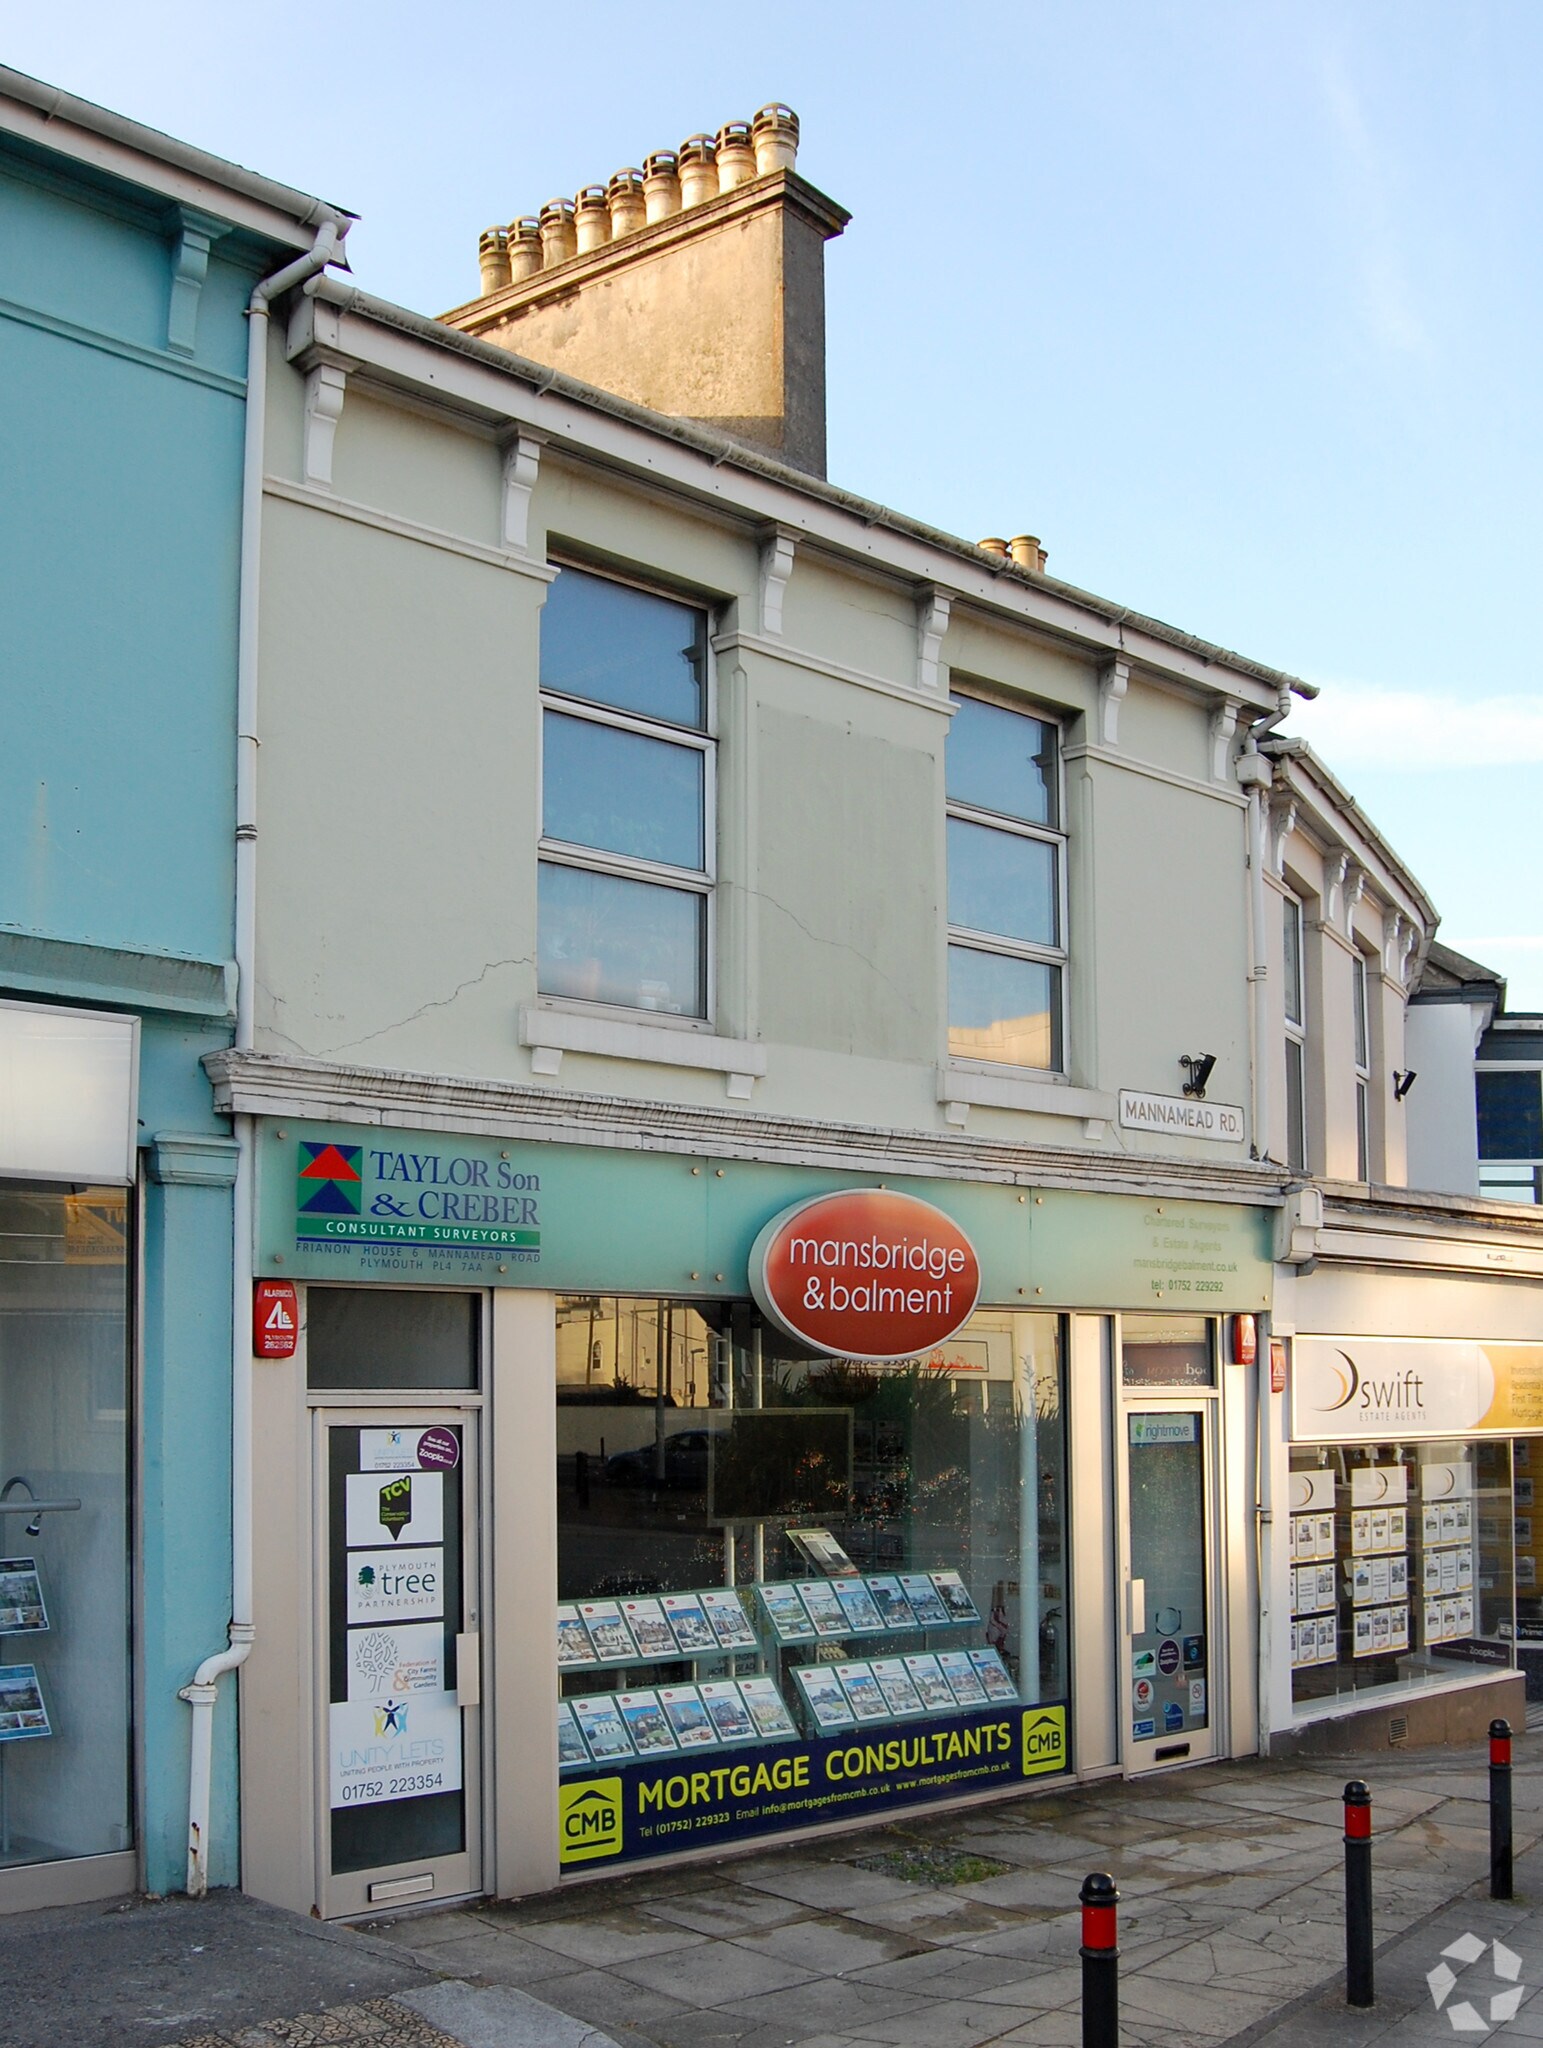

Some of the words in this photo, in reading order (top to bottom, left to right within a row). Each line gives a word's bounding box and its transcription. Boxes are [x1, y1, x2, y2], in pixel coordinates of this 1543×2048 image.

[1125, 1100, 1214, 1128] MANNAMEAD
[370, 1150, 490, 1188] TAYLOR
[497, 1162, 541, 1192] Son
[370, 1193, 414, 1218] &
[418, 1190, 540, 1225] CREBER
[326, 1222, 426, 1238] CONSULTANT
[434, 1227, 516, 1242] SURVEYORS
[363, 1246, 402, 1257] HOUSE
[412, 1247, 419, 1258] 6
[428, 1249, 502, 1262] MANNAMEAD
[512, 1252, 540, 1263] ROAD
[1164, 1238, 1189, 1250] Estate
[1193, 1239, 1222, 1253] Agents
[360, 1258, 423, 1270] PLYMOUTH
[432, 1260, 452, 1271] PL4
[462, 1262, 482, 1272] 7AA
[790, 1235, 966, 1280] mansbridge
[1168, 1280, 1191, 1291] 01752
[1360, 1370, 1424, 1408] swift
[1360, 1412, 1390, 1421] ESTATE
[1394, 1411, 1426, 1421] AGENTS
[1146, 1424, 1190, 1440] rightmove
[381, 1477, 411, 1500] TCV
[380, 1562, 436, 1572] PLYMOUTH
[382, 1573, 435, 1595] tree
[358, 1597, 436, 1608] PARTNERSHIP
[340, 1745, 394, 1768] UNITY
[401, 1739, 444, 1760] LETS
[1027, 1730, 1062, 1755] CMB
[368, 1764, 392, 1774] PEOPLE
[639, 1756, 810, 1814] MORTGAGE
[826, 1722, 1012, 1781] CONSULTANTS
[342, 1782, 383, 1800] 01752
[390, 1773, 442, 1794] 223354
[565, 1808, 616, 1838] CMB
[640, 1826, 653, 1838] Tel
[656, 1818, 692, 1836] (01752)
[696, 1812, 730, 1828] 229323
[736, 1807, 759, 1820] Email
